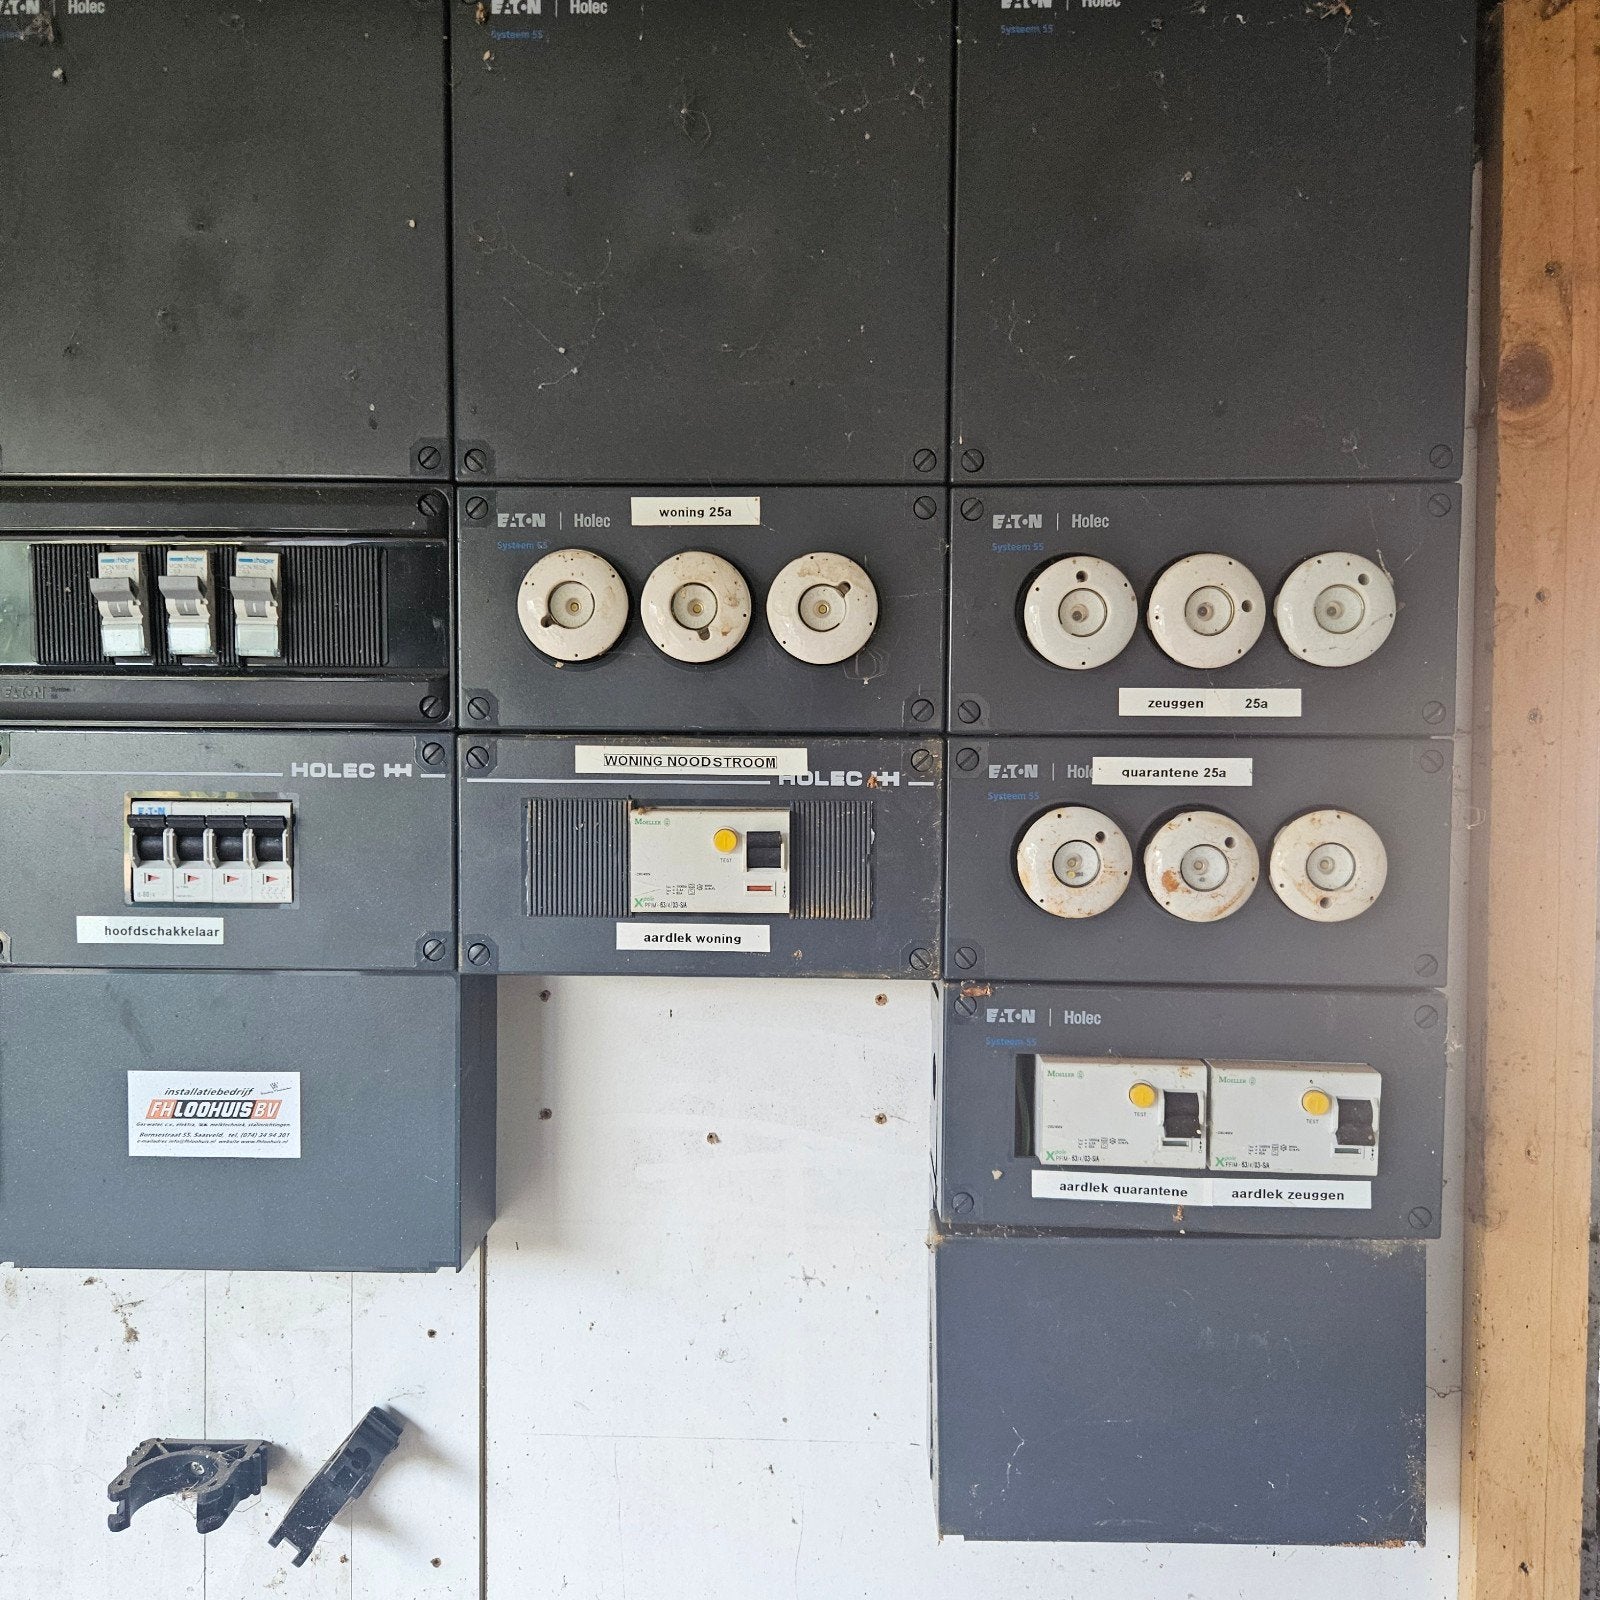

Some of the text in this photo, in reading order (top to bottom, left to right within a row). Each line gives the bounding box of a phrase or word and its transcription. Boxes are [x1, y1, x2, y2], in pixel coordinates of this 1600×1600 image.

[0, 0, 106, 15] ATON Holec
[569, 0, 608, 14] Holec
[659, 507, 732, 519] woning 25a
[497, 513, 611, 528] EATON Holec
[992, 513, 1110, 529] EATON Holec
[497, 541, 535, 551] Systeem
[991, 543, 1045, 553] Systeem 55
[1148, 698, 1268, 710] zeuggen 25a
[605, 755, 776, 769] WONING NOODSTROOM
[291, 762, 376, 779] HOLEC
[988, 764, 1038, 779] EATON
[1121, 767, 1227, 779] quarantene 25a
[987, 792, 1026, 802] Systeem
[104, 926, 220, 937] hoofdschakkelaar
[644, 933, 742, 945] aardlek woning
[986, 1008, 1102, 1025] EATON Holec
[985, 1036, 1023, 1047] Systeem
[164, 1087, 255, 1098] installatiebedrijf
[1059, 1182, 1188, 1197] aardlek quarantene
[1231, 1188, 1345, 1201] aardlek zeuggen
